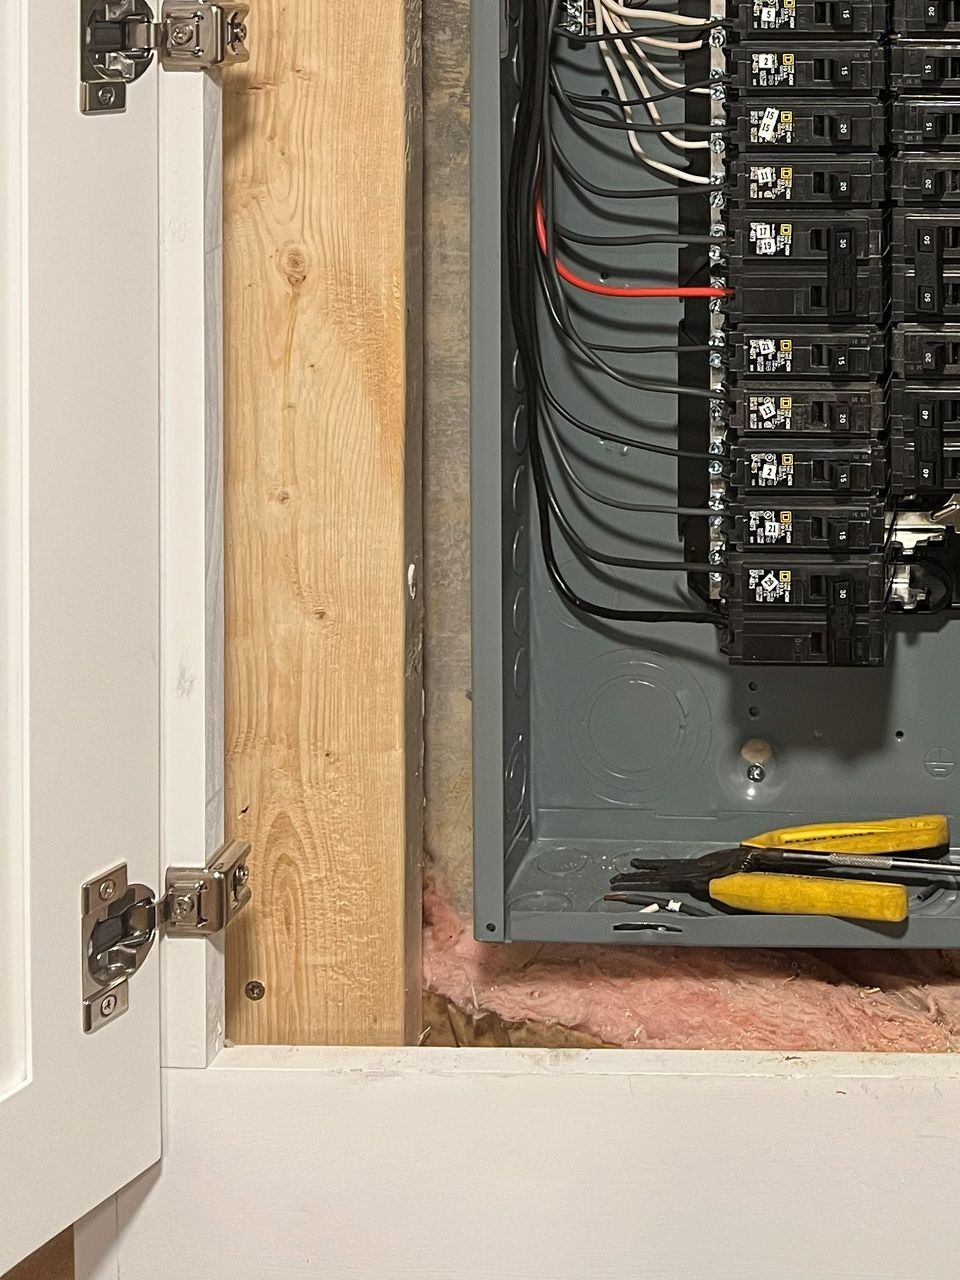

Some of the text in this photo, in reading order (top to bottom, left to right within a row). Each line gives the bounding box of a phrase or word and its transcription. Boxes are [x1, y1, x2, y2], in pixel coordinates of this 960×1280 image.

[842, 9, 850, 19] 15
[928, 6, 935, 16] 20
[841, 66, 849, 76] 15
[924, 64, 932, 74] 15
[840, 123, 848, 134] 20
[925, 121, 933, 132] 15
[840, 181, 847, 192] 20
[925, 179, 932, 189] 20
[839, 239, 847, 249] 30
[923, 235, 931, 245] 50
[924, 292, 931, 303] 50
[838, 356, 846, 366] 15
[925, 352, 932, 363] 20
[839, 413, 847, 424] 20
[921, 410, 929, 420] 40
[840, 473, 848, 483] 15
[922, 468, 930, 479] 40
[839, 531, 847, 541] 15
[839, 589, 847, 599] 30
